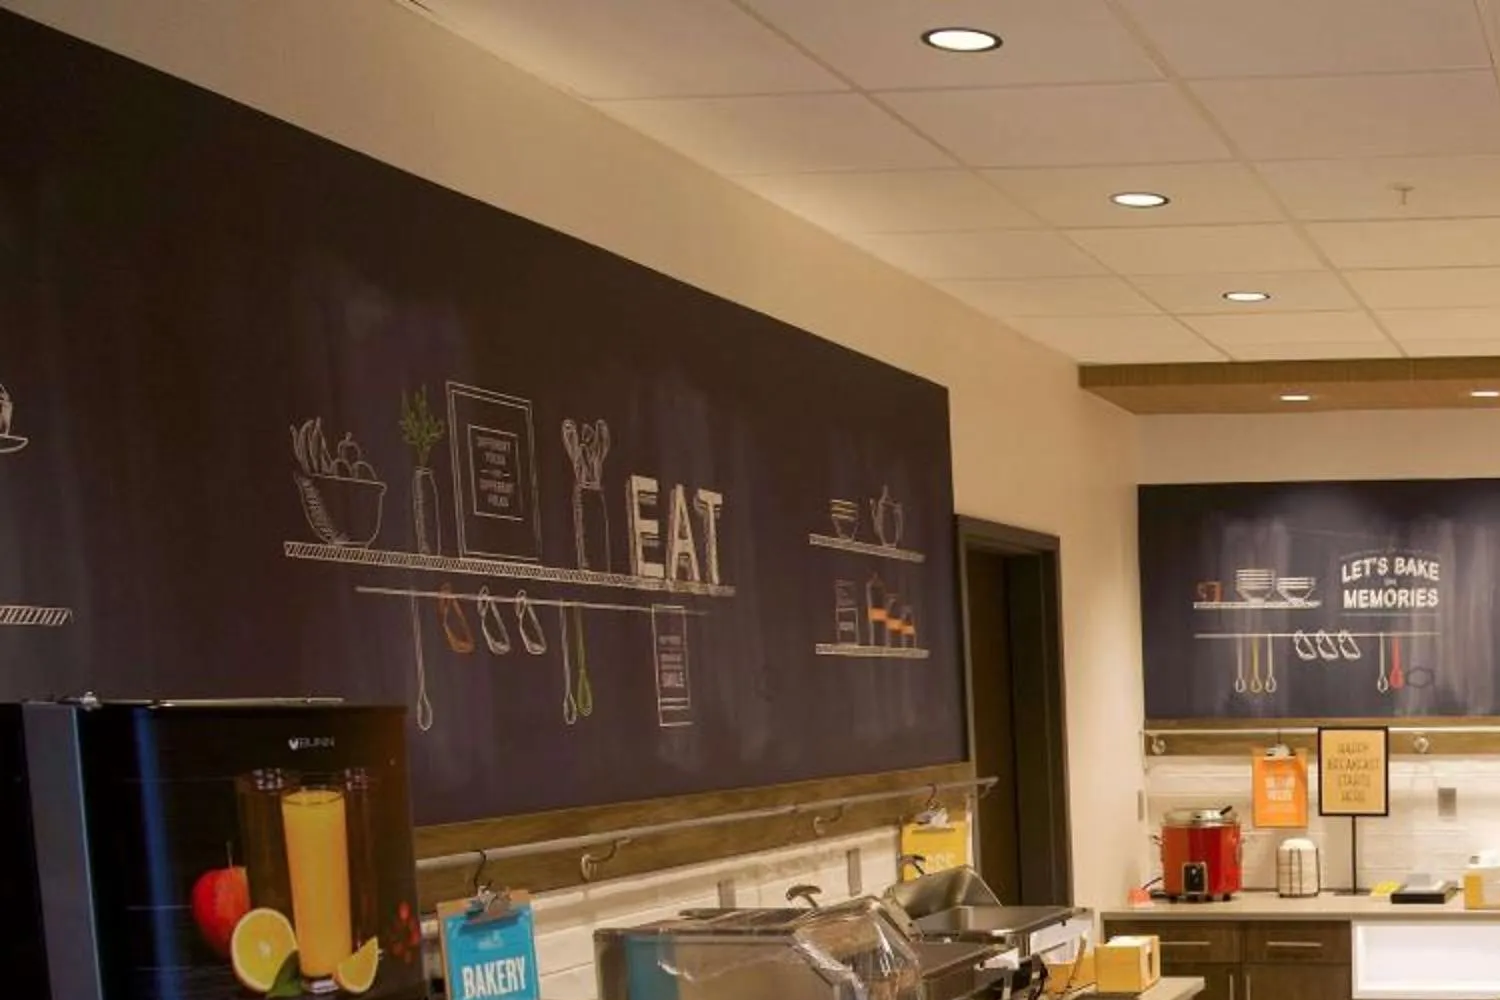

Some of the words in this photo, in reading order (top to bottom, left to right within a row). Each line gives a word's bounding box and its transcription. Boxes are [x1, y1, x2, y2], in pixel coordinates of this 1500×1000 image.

[626, 475, 723, 585] EAT
[1342, 556, 1389, 584] LET'S
[1394, 557, 1441, 582] BAKE
[1343, 587, 1440, 609] MEMORIES
[462, 956, 526, 1000] BAKERY
